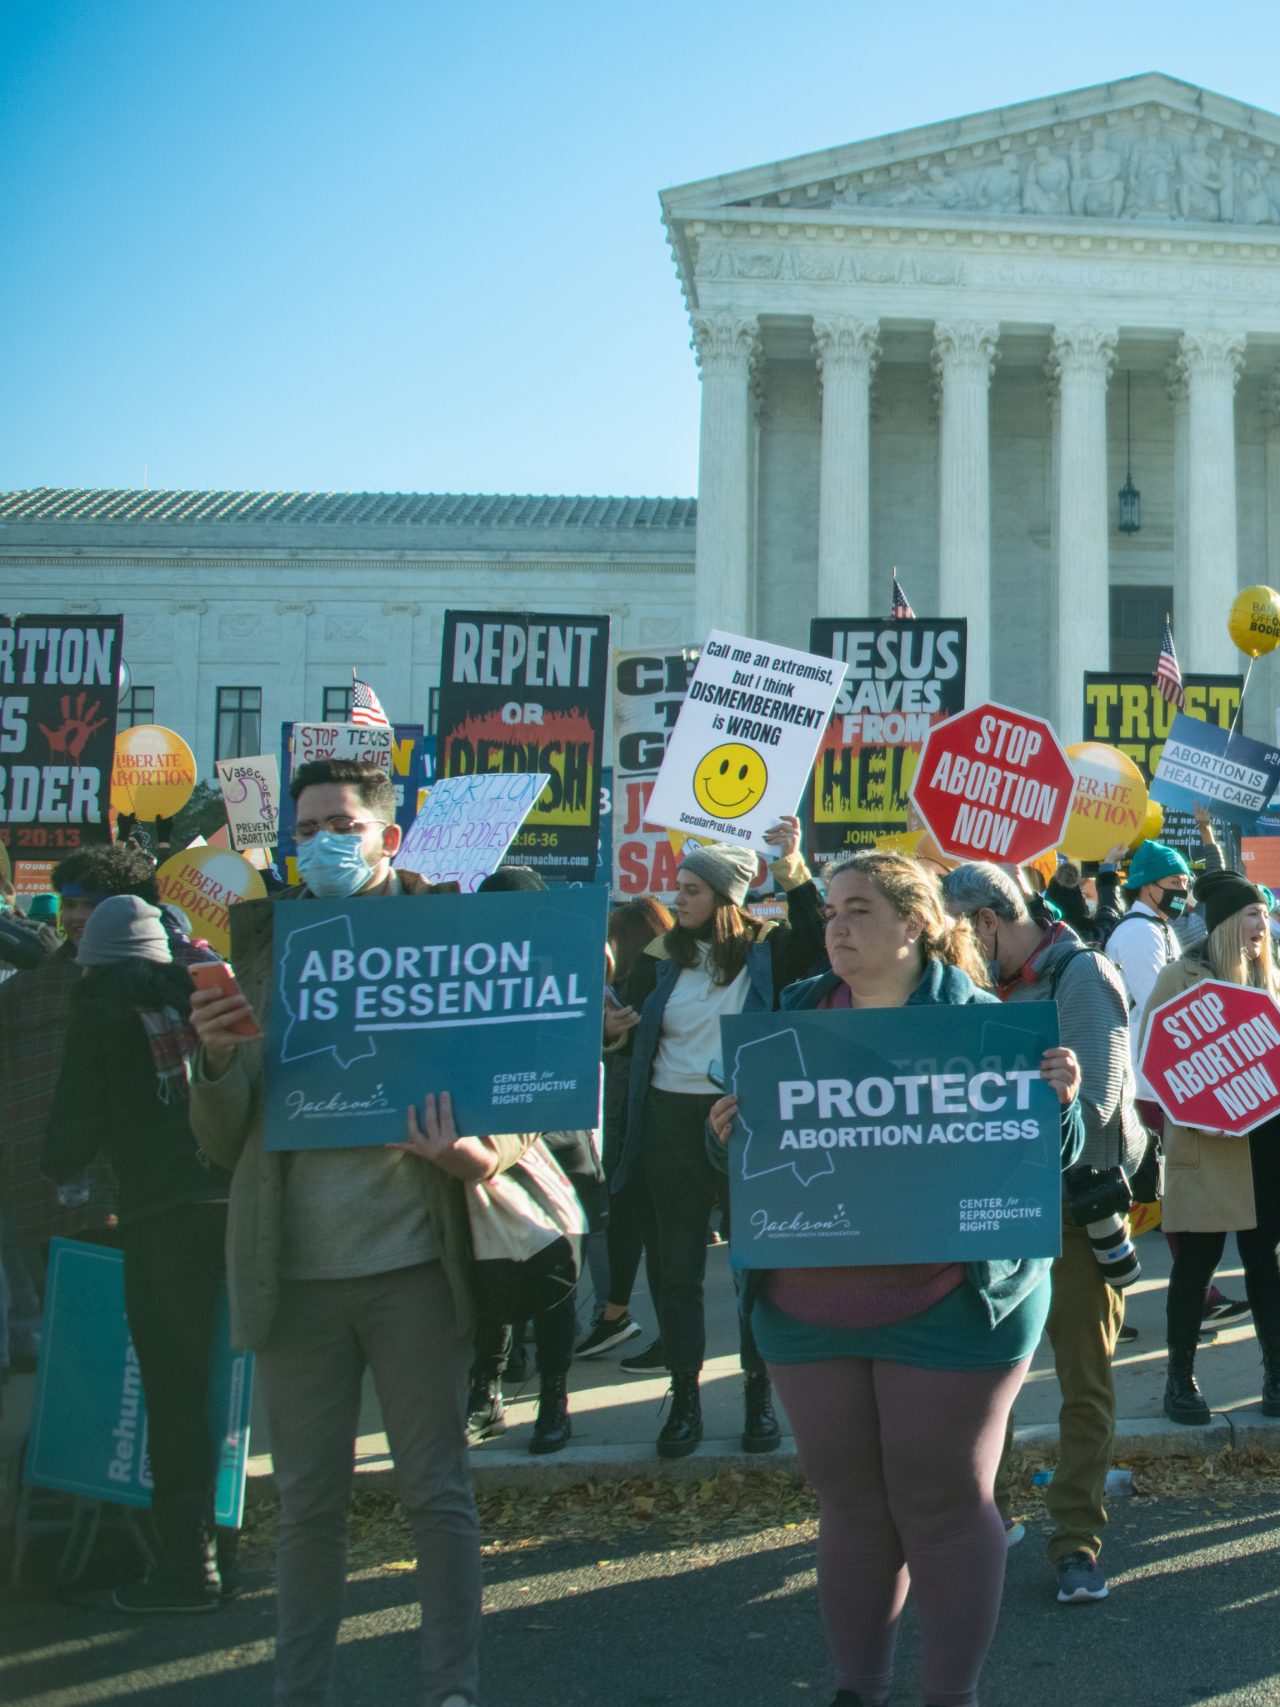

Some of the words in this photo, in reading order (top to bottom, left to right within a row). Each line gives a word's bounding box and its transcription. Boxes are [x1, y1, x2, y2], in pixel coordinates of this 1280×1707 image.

[984, 263, 1066, 285] EQUAL
[1072, 266, 1168, 288] JUSTICE
[1179, 270, 1258, 293] UNDER
[452, 622, 598, 687] REPENT
[707, 641, 731, 659] Call
[731, 649, 752, 664] me
[753, 654, 770, 668] an
[772, 658, 833, 685] extremist,
[832, 630, 959, 680] JESUS
[732, 670, 755, 686] but
[754, 675, 761, 689] I
[763, 677, 795, 697] think
[834, 680, 942, 714] SAVES
[501, 702, 544, 725] OR
[689, 680, 825, 730] DISMEMBERMENT
[0, 697, 29, 753] S
[301, 726, 339, 747] STOP
[347, 729, 390, 746] TEXAS
[712, 714, 725, 730] is
[726, 716, 782, 746] WRONG
[842, 714, 931, 744] FROM
[974, 715, 1042, 768] STOP
[116, 754, 181, 768] LIBERATE
[1170, 746, 1246, 781] ABORTION
[1248, 772, 1263, 787] IS
[432, 775, 537, 803] ABORTION
[822, 746, 911, 813] HEL
[929, 751, 1059, 825] ABORTION
[1077, 775, 1132, 804] ERATE
[1163, 765, 1220, 795] HEALTH
[1223, 787, 1261, 808] CARE
[236, 821, 276, 833] PREVENT
[679, 812, 752, 840] SecularProLife.org
[1072, 795, 1141, 831] RTION
[16, 829, 80, 848] 20:13
[236, 831, 279, 845] ABORTION
[455, 822, 519, 849] BODIES
[951, 803, 1017, 856] NOW
[502, 854, 589, 867] treetpreachers.com
[299, 940, 531, 983] ABORTION
[299, 988, 339, 1021] IS
[355, 974, 588, 1019] ESSENTIAL
[1162, 992, 1227, 1050] STOP
[492, 1080, 577, 1094] REPRODUCTIVE
[493, 1072, 537, 1084] CENTER
[1212, 1063, 1278, 1121] NOW
[285, 1090, 388, 1120] Jackson
[492, 1094, 533, 1105] RIGHTS
[778, 1070, 1041, 1121] PROTECT
[779, 1123, 923, 1150] ABORTION
[927, 1119, 1040, 1144] ACCESS
[959, 1198, 1002, 1209] CENTER
[960, 1207, 1042, 1220] REPRODUCTIVE
[750, 1209, 850, 1240] Jackson
[960, 1220, 1000, 1231] RIGHTS
